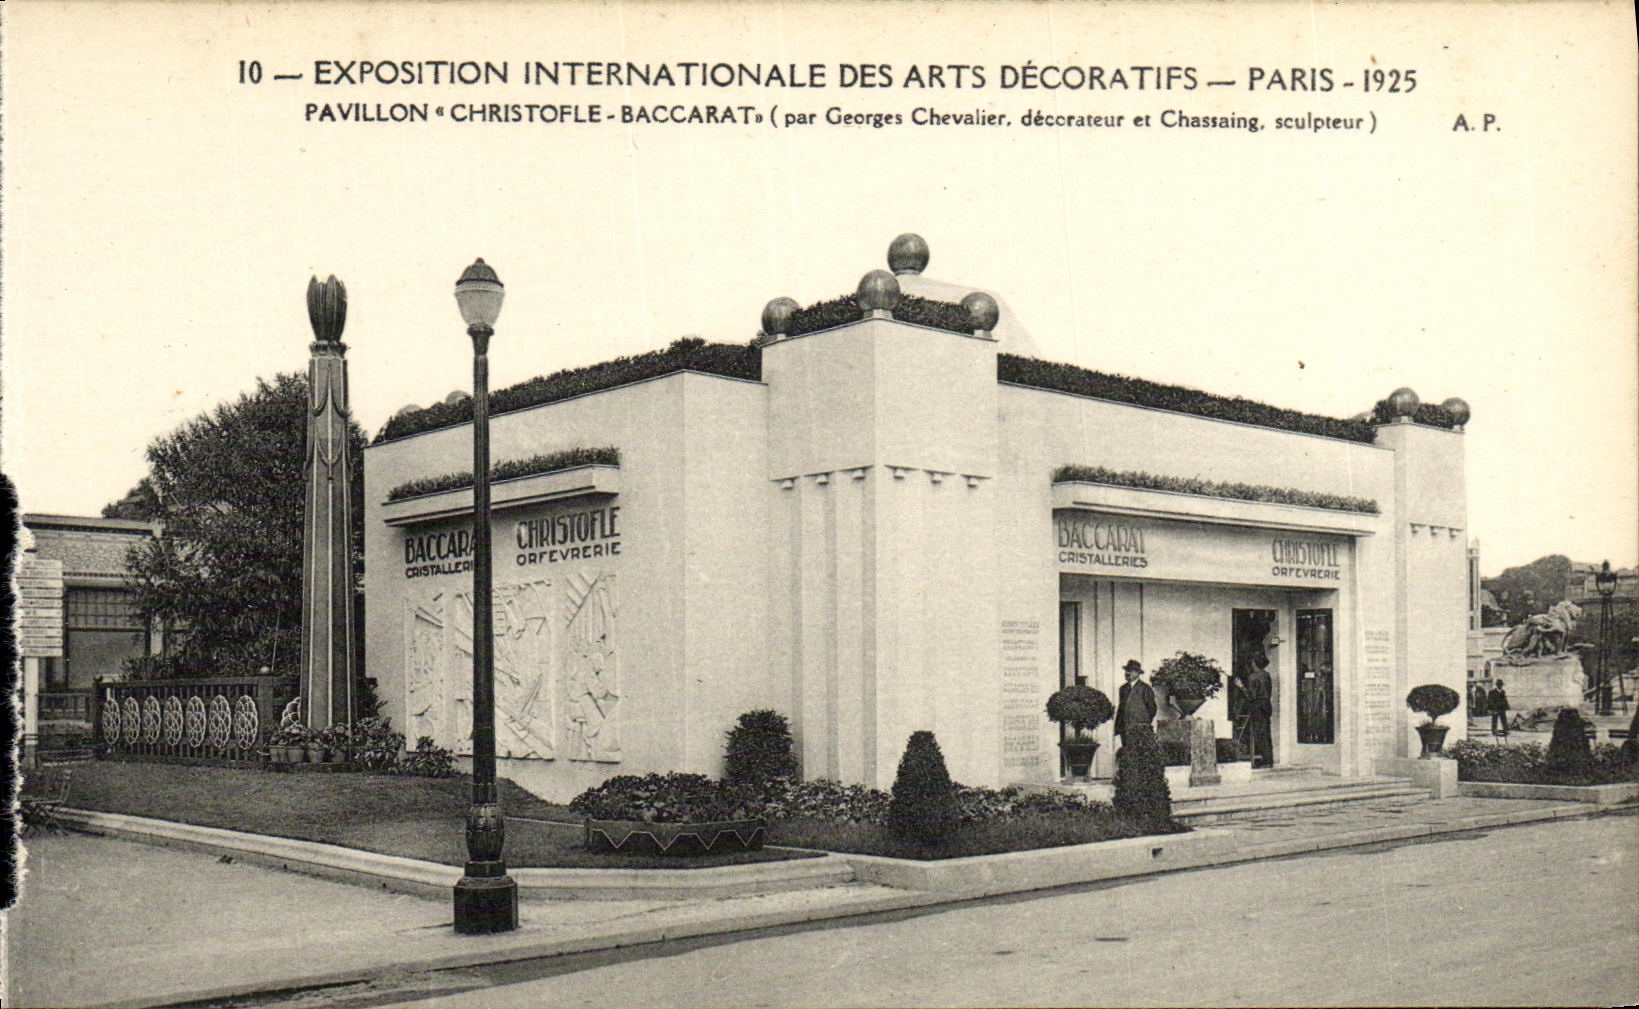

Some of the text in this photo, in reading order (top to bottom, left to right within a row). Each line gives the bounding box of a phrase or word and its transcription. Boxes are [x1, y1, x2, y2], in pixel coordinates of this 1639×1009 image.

[516, 506, 621, 550] CHRISTOFLE
[1058, 517, 1146, 554] BACCARAT
[405, 530, 476, 565] BACCARA
[516, 541, 621, 566] ORFEVRERIE
[1058, 551, 1148, 569] CRISTALLERIES
[1272, 536, 1340, 567] CHRISTOFLE
[405, 560, 475, 579] CRISTALLERI
[1272, 565, 1340, 580] ORFEVRERIE
